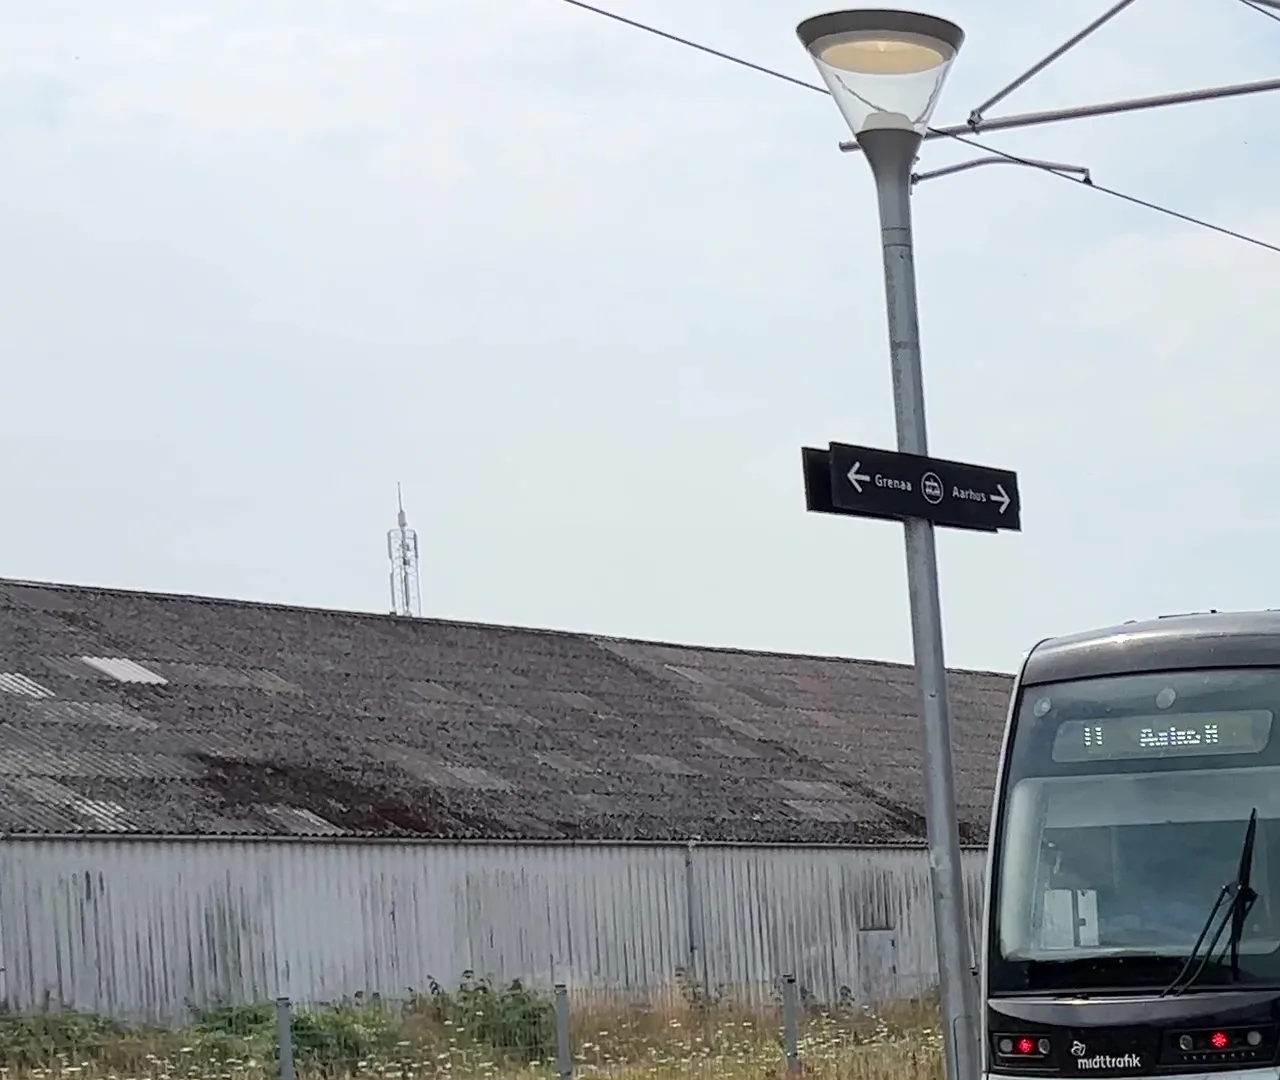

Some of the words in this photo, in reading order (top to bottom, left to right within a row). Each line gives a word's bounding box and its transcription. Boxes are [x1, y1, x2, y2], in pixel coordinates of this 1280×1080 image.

[875, 474, 912, 491] Grenaa
[952, 486, 987, 503] Aarhus
[1078, 1052, 1141, 1070] midttrafik
